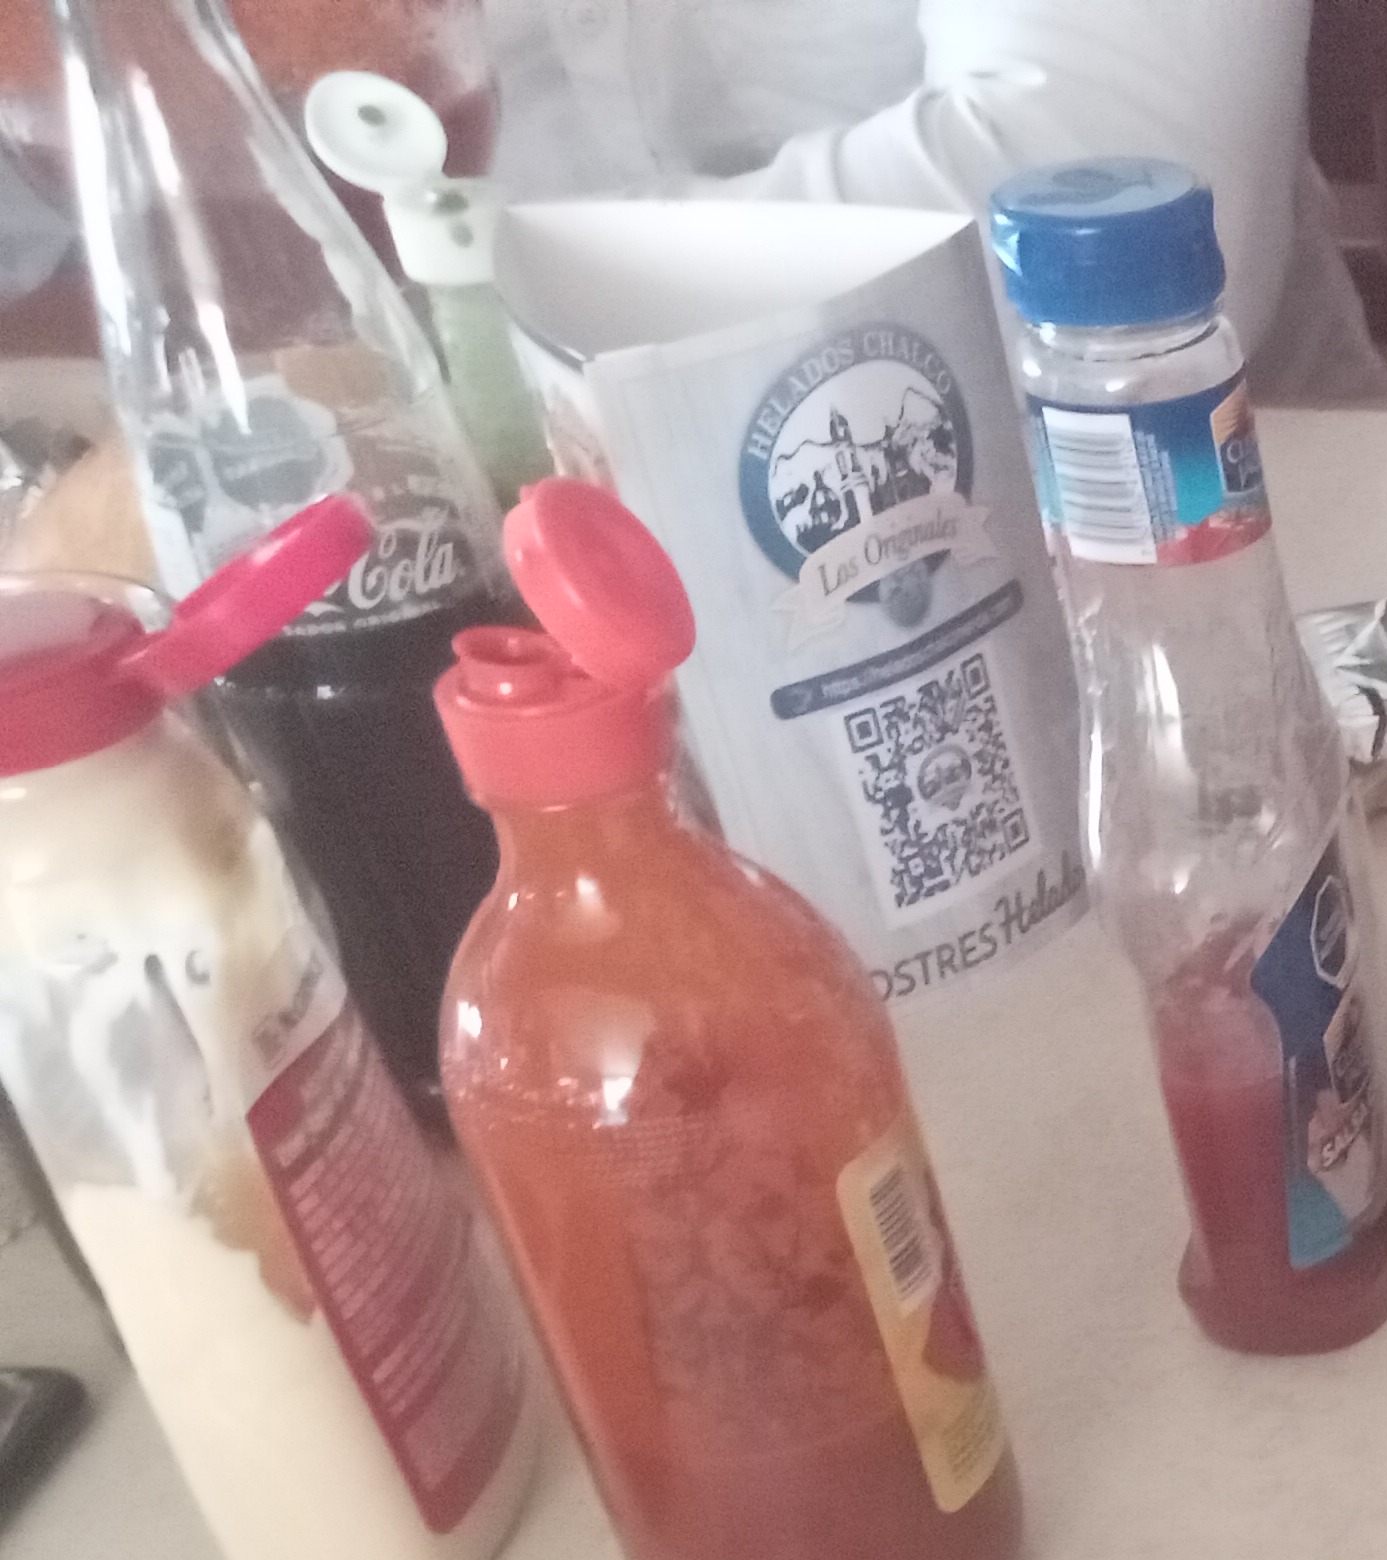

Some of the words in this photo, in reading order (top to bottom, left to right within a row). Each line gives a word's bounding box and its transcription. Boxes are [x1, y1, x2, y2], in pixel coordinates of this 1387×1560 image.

[744, 336, 857, 463] HELADOS
[862, 330, 956, 396] CHALCO
[868, 921, 998, 1003] OSTRES
